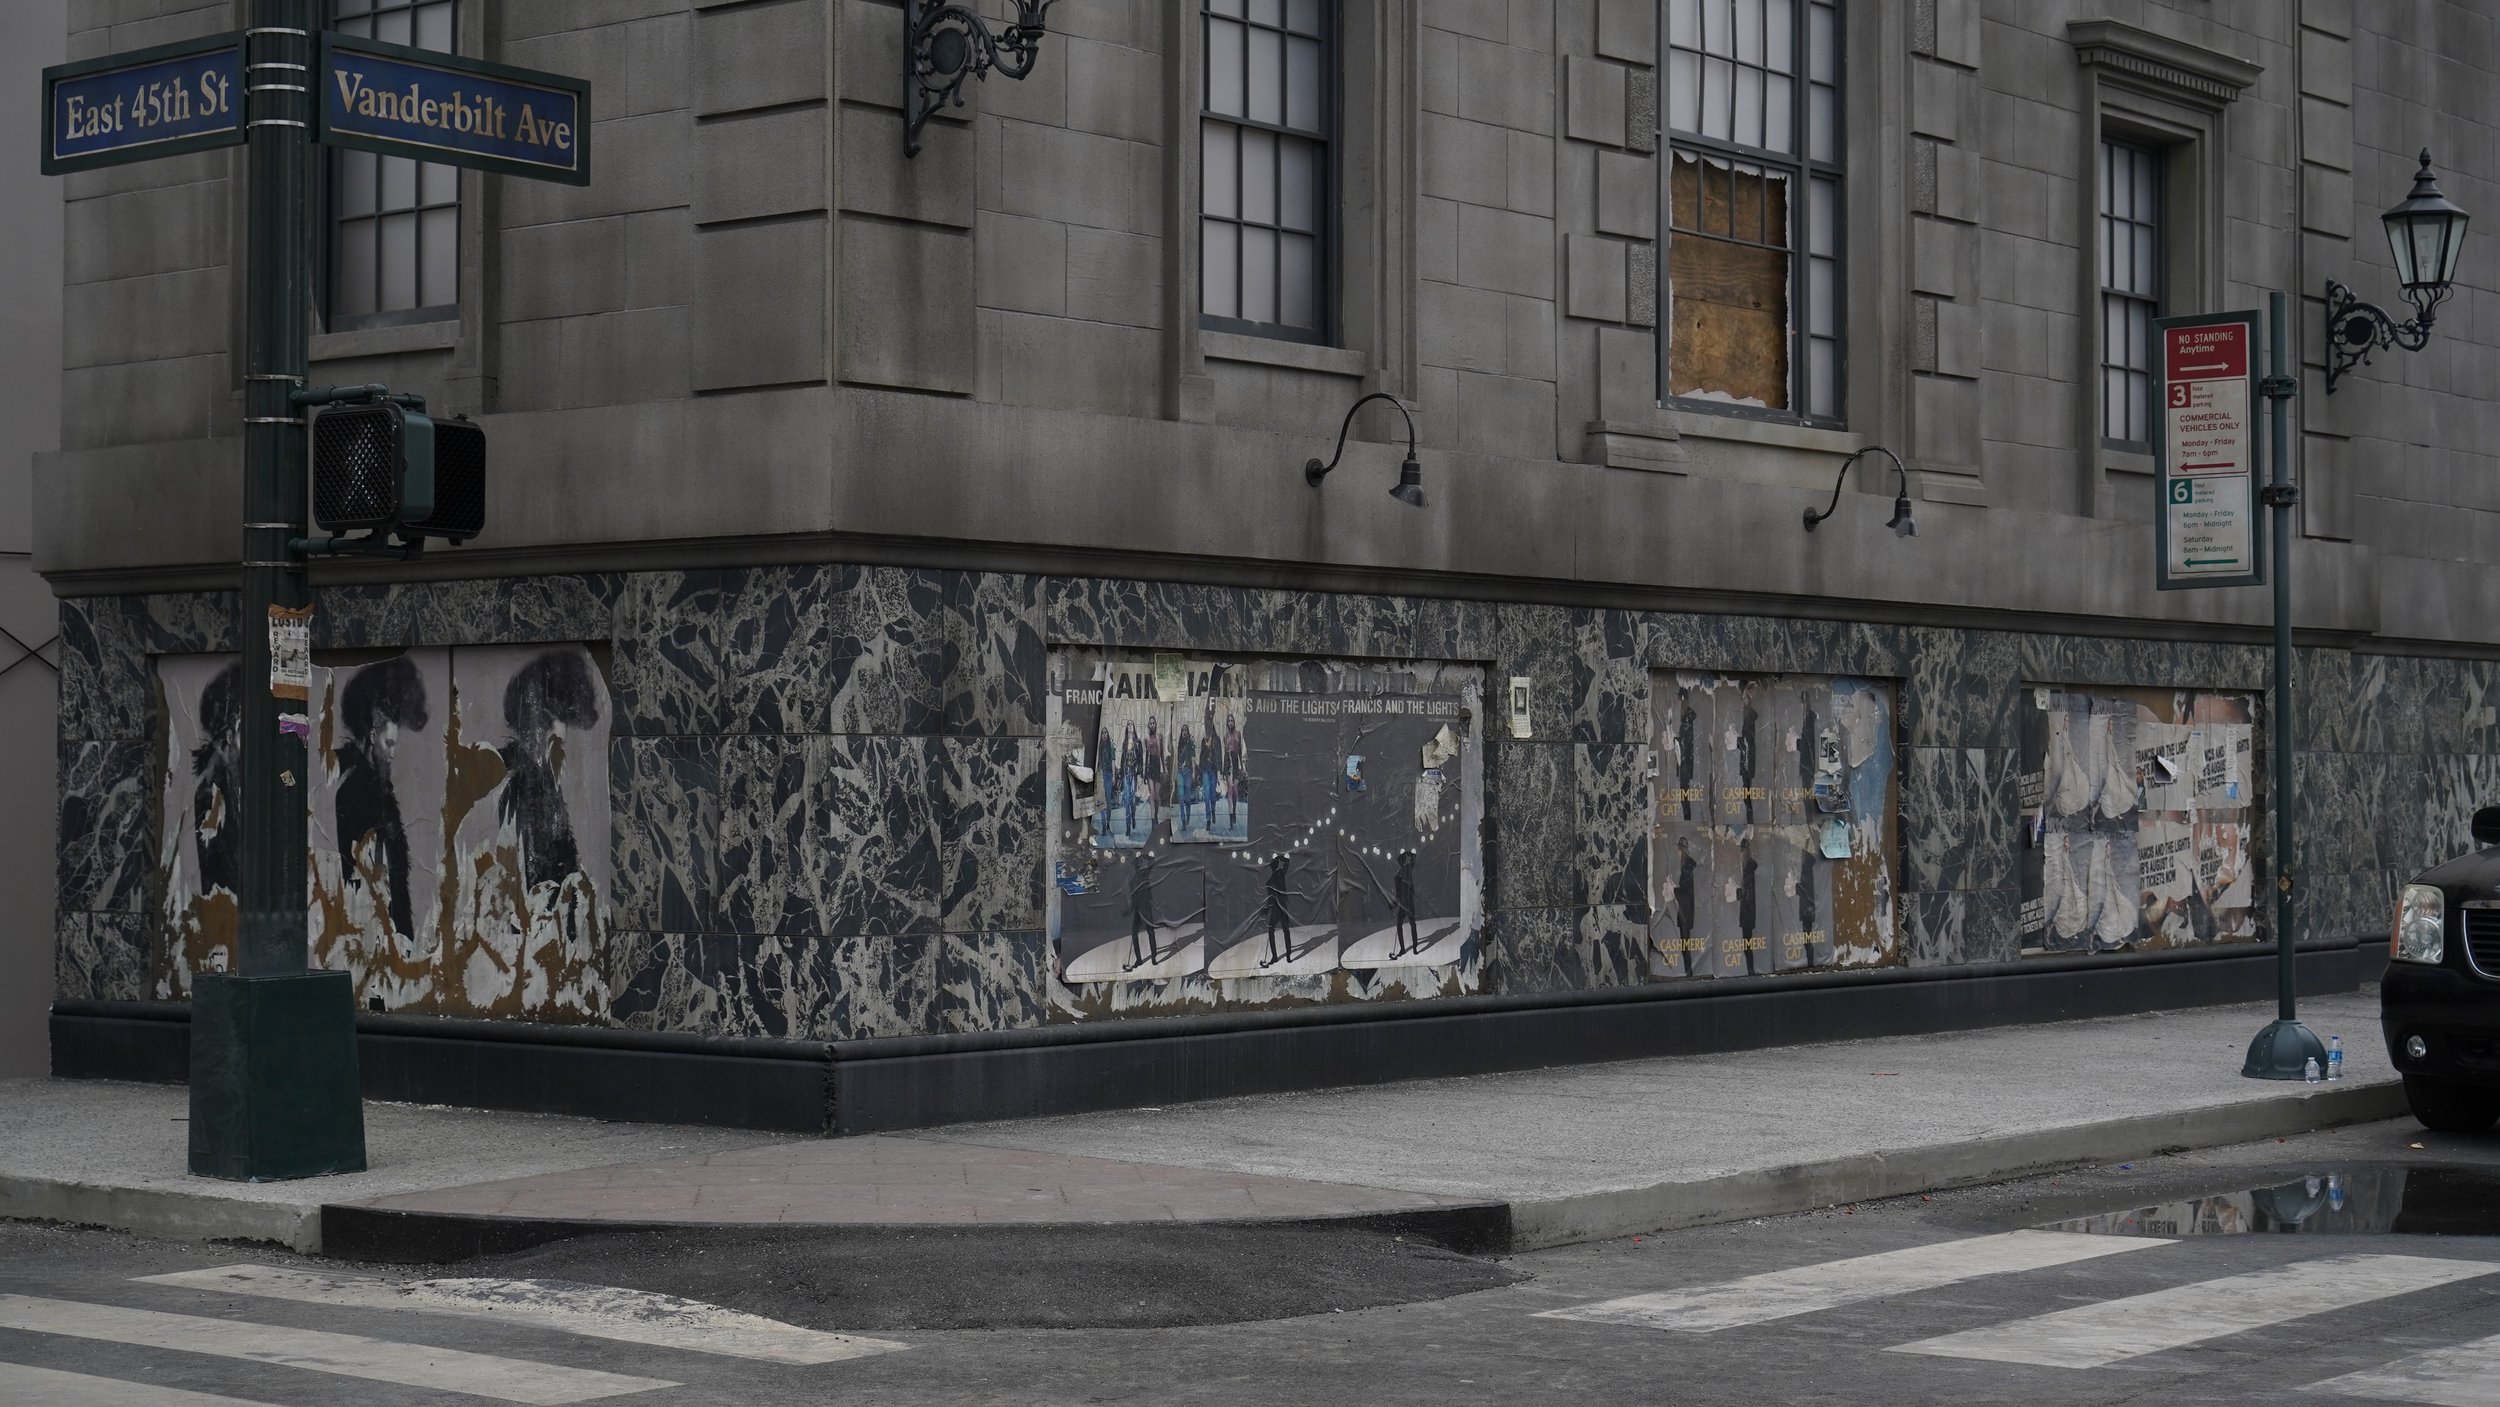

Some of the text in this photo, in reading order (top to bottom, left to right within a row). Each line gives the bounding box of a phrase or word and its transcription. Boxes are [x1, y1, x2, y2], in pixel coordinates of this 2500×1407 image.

[66, 70, 229, 140] East 45th St
[334, 69, 571, 151] Vanderbilt Ave
[2179, 332, 2233, 344] NO STANDING
[2179, 344, 2215, 355] Anytime
[2172, 385, 2187, 406] 3
[2180, 413, 2232, 423] COMMERCIAL
[2180, 422, 2240, 433] VEHICLES ONLY
[2182, 439, 2209, 448] Monday
[2214, 438, 2236, 446] Friday
[2182, 450, 2197, 458] 7am
[2202, 450, 2219, 458] 6pm
[2174, 481, 2189, 502] 6
[2183, 511, 2209, 519] Monday
[2183, 521, 2198, 529] 6pm
[2204, 520, 2232, 528] Midnight
[2183, 536, 2214, 544] Saturday
[2204, 545, 2233, 553] Midnight
[272, 631, 281, 673] REWARD
[1256, 699, 1277, 713] AND
[1281, 699, 1299, 714] THE
[1302, 700, 1337, 715] LIGHTS
[1343, 699, 1460, 716] FRANCIS AND THE LIGHTS
[2136, 746, 2155, 763] FRANCIS
[2156, 744, 2165, 758] AND
[2166, 743, 2175, 757] THE
[1660, 789, 1703, 801] CASHMERE
[1723, 788, 1765, 800] CASHMERE
[1662, 804, 1679, 816] CAT
[1725, 801, 1742, 814] CAT
[2155, 843, 2164, 857] AND
[2165, 841, 2174, 855] THE
[2175, 837, 2190, 852] LIGHTS
[2150, 857, 2168, 874] AUGUST
[2169, 856, 2174, 868] 12
[2146, 873, 2165, 888] TICKETS
[2166, 869, 2176, 883] NOW
[1783, 930, 1825, 945] CASHMERE
[1660, 938, 1705, 953] CASHMERE
[1723, 937, 1766, 953] CASHMERE
[1786, 946, 1803, 960] CAT
[1663, 954, 1680, 967] CAT
[1725, 954, 1742, 967] CAT
